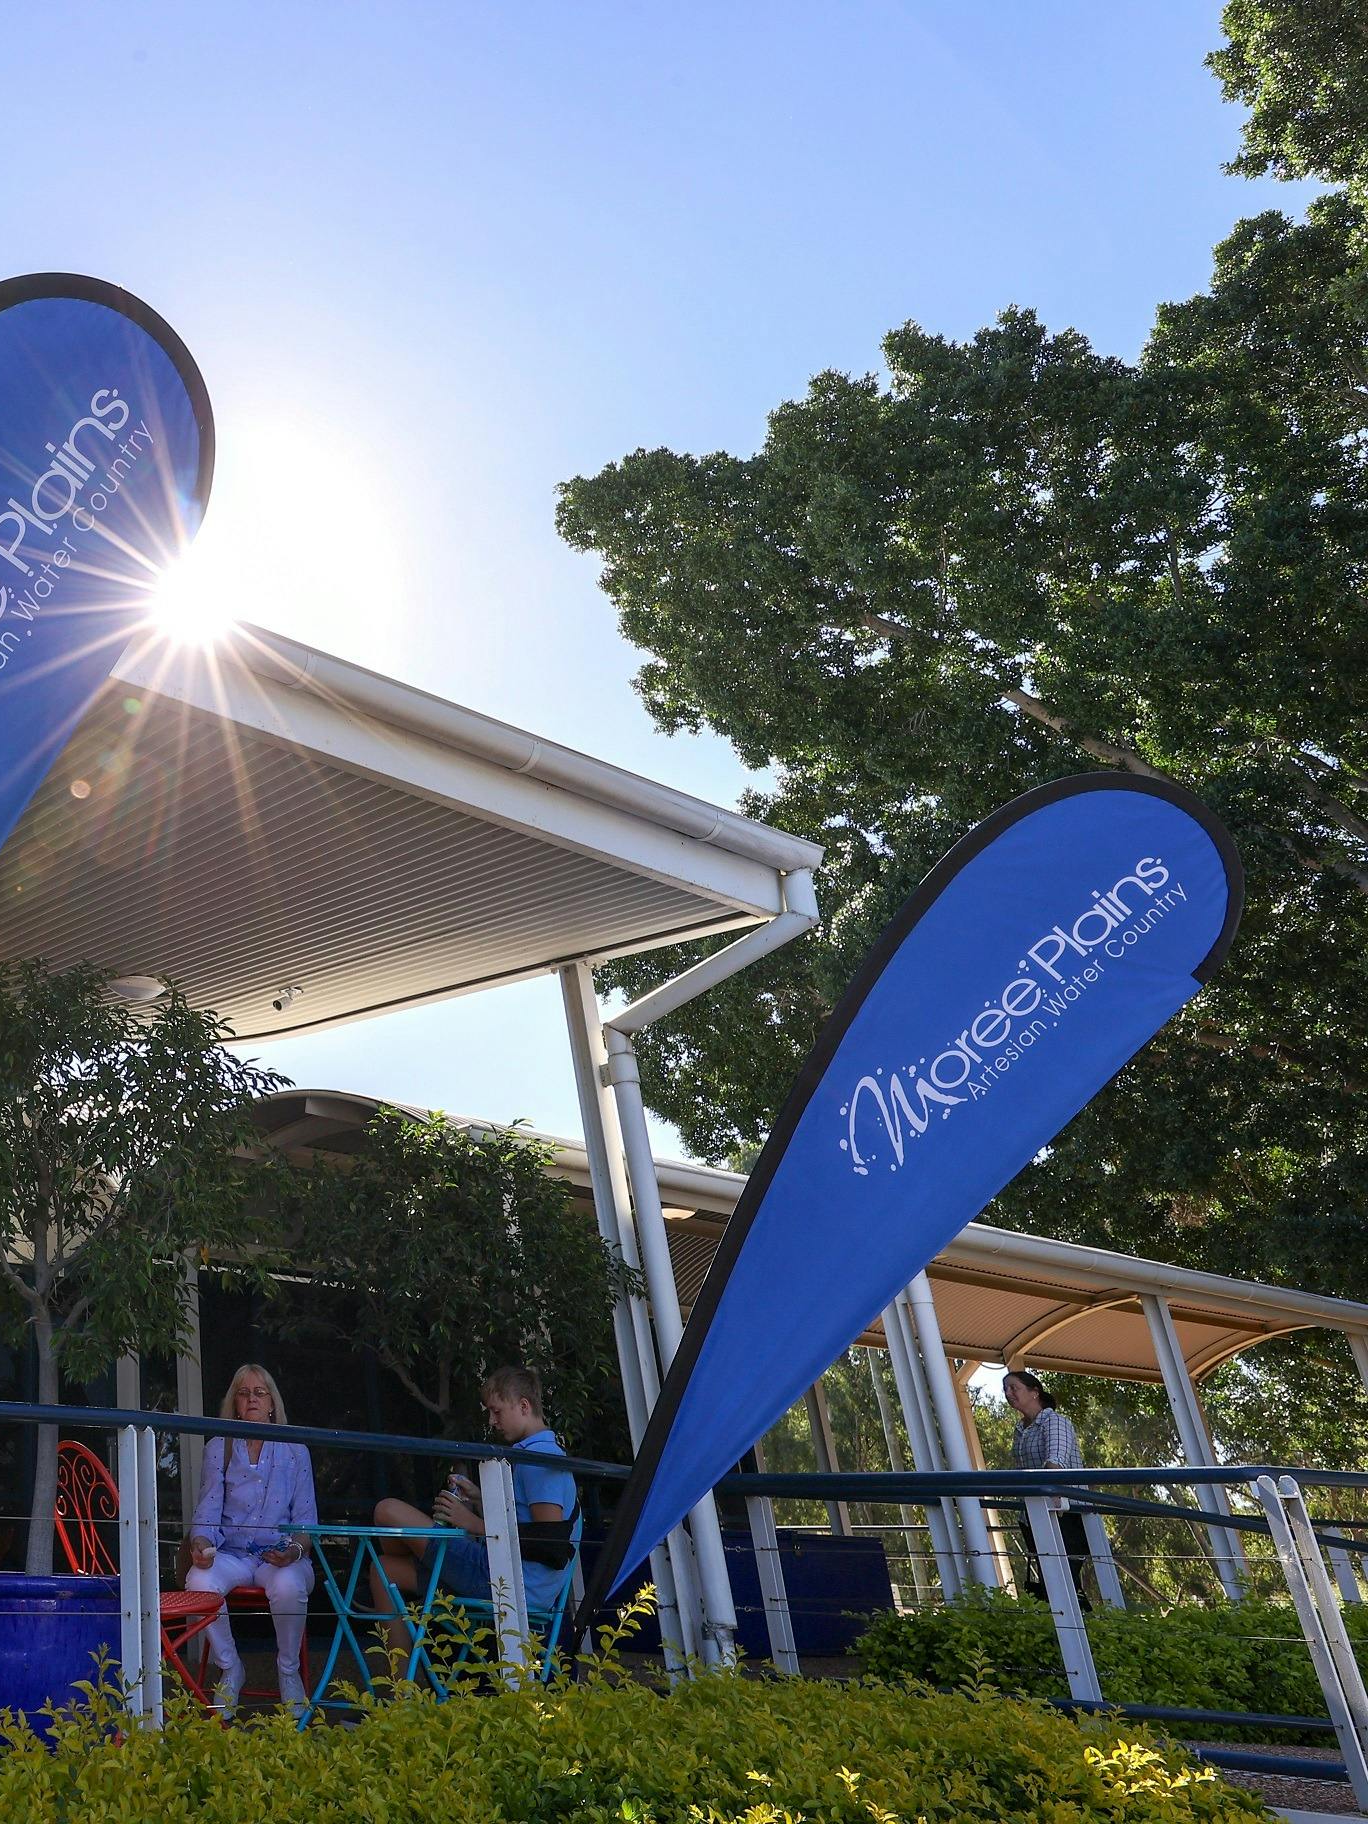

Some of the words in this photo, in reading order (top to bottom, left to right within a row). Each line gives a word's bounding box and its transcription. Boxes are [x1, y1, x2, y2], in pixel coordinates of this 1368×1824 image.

[10, 536, 78, 622] Water
[72, 418, 154, 533] Country
[846, 977, 1042, 1170] Moree
[1027, 856, 1170, 982] Plains
[967, 1019, 1048, 1101] Artesian
[1042, 958, 1105, 1017] Water
[1104, 882, 1188, 959] Country
